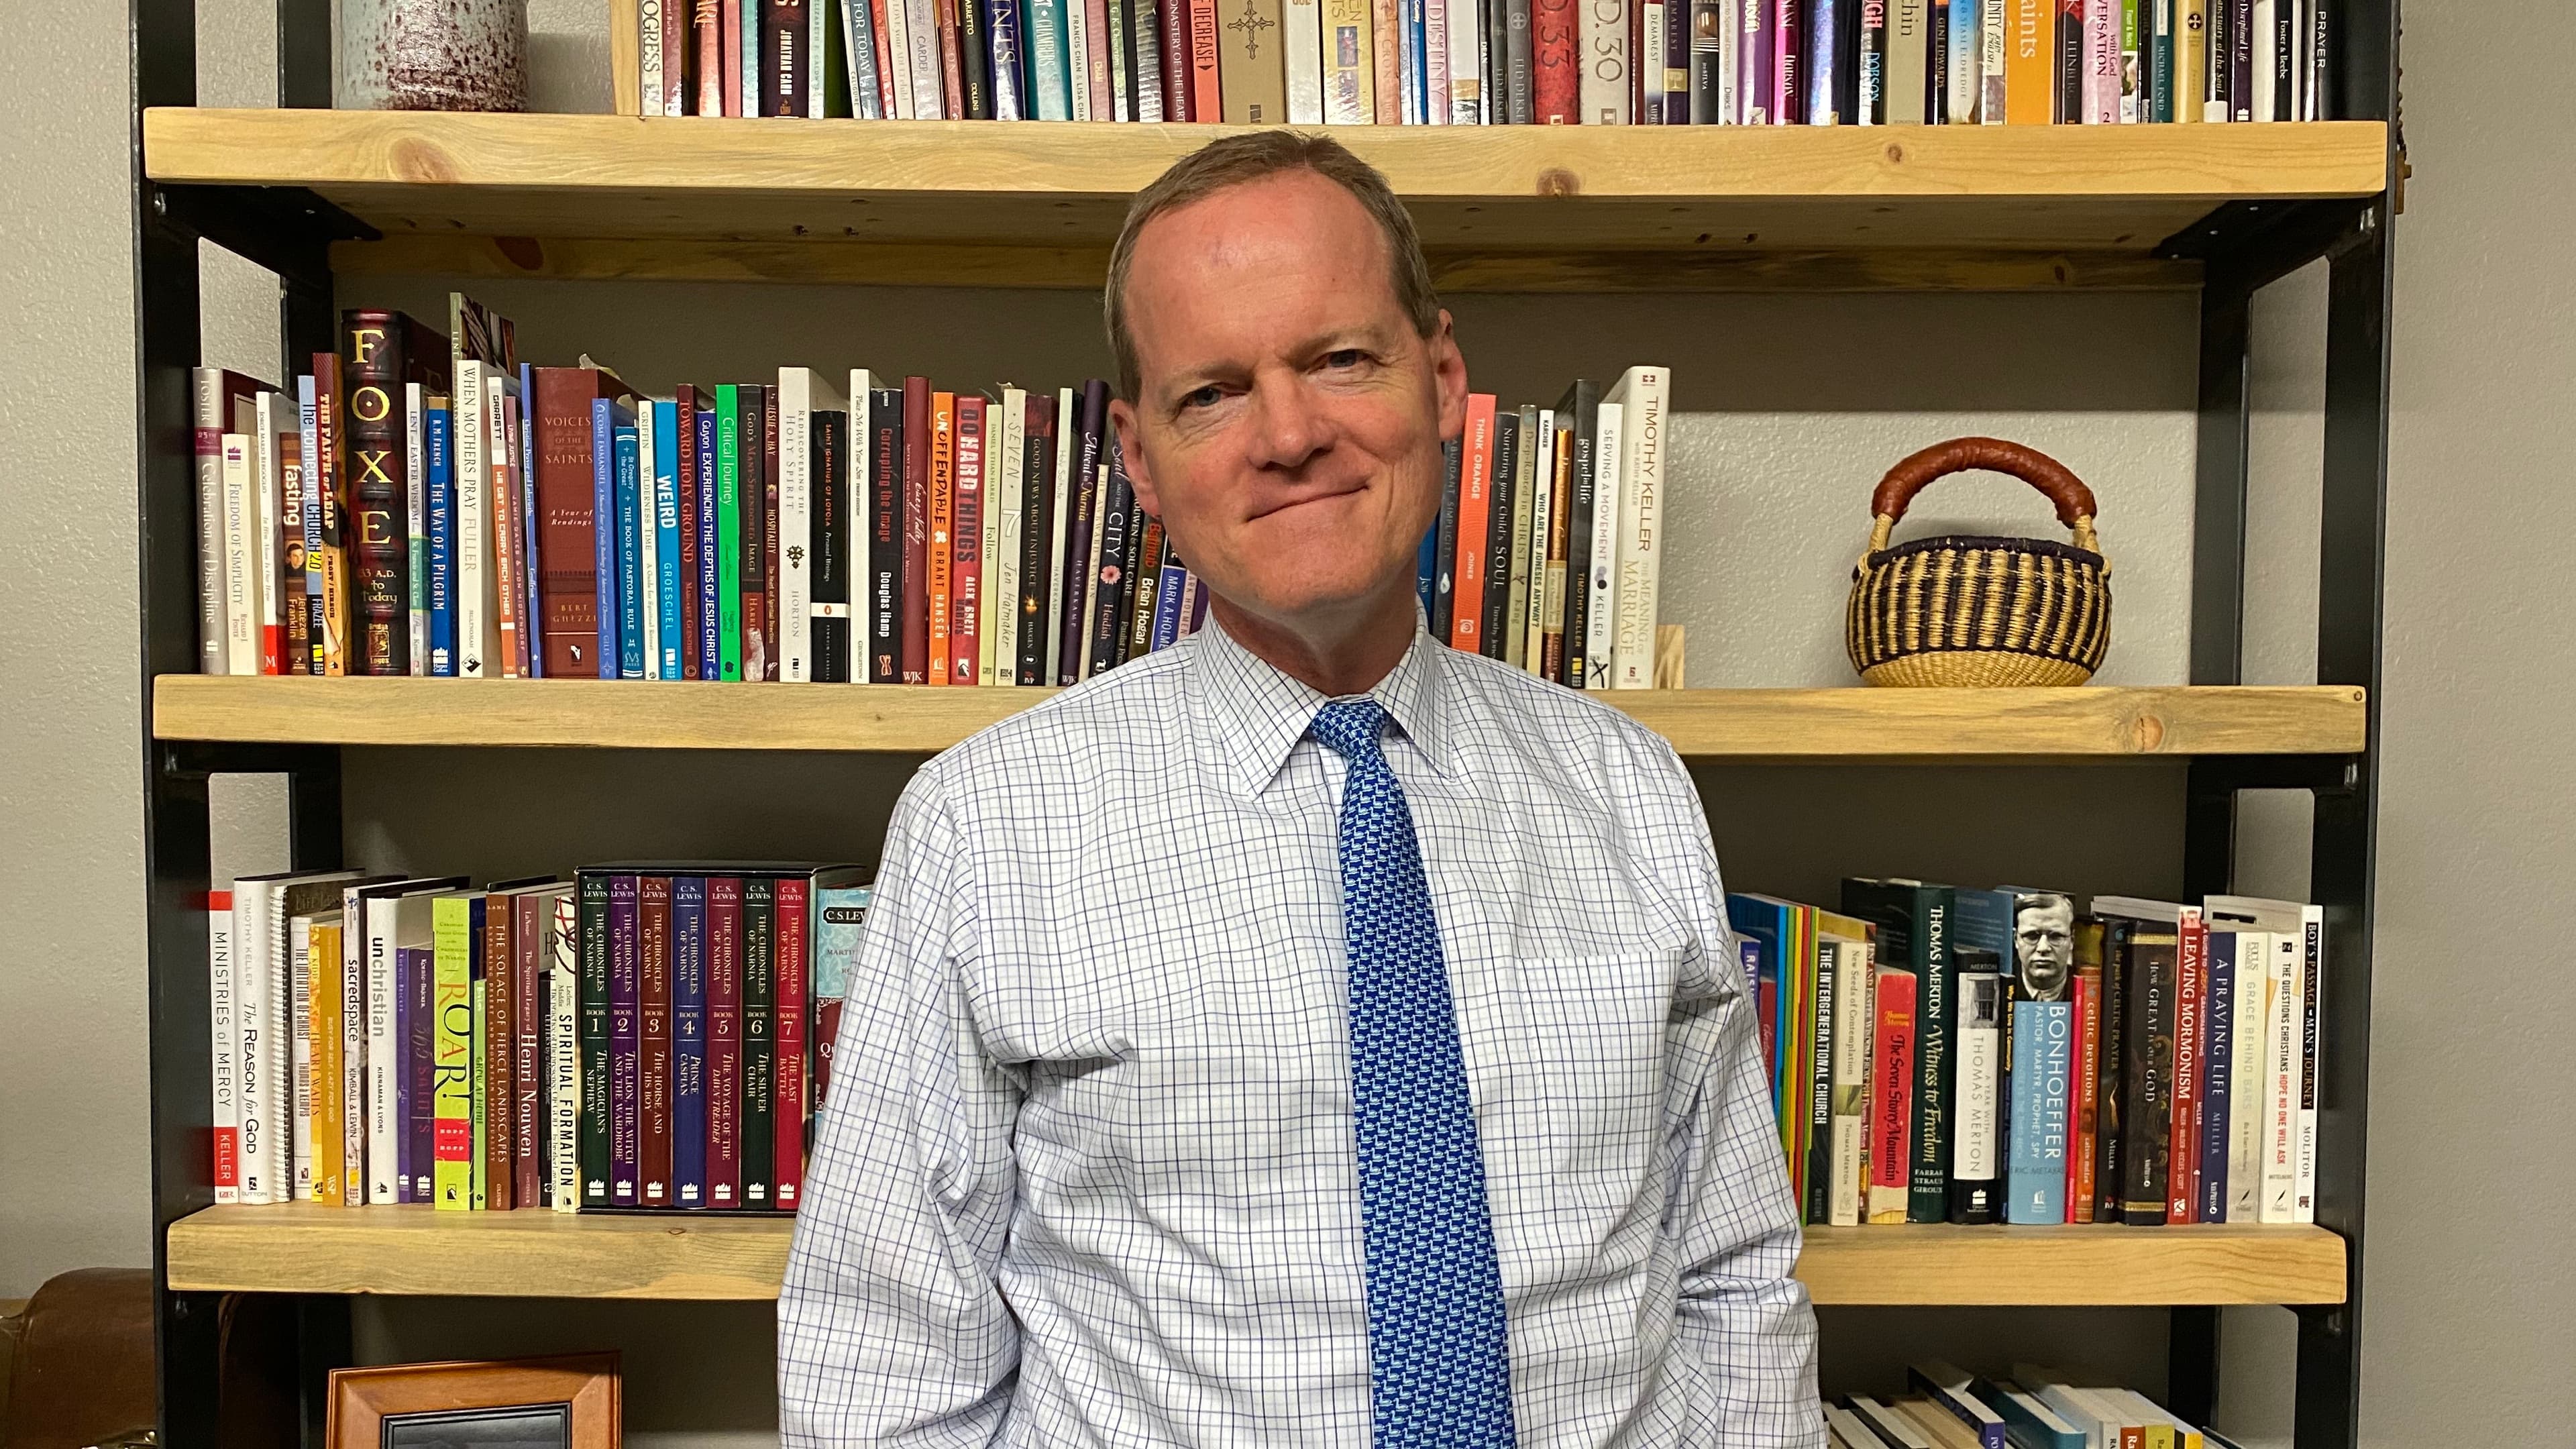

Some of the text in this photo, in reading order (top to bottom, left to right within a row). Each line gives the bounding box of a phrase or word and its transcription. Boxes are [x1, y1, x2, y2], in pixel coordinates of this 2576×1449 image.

[780, 30, 792, 70] JONATHAN
[853, 3, 870, 72] FOR TODAY
[1036, 19, 1056, 66] CHAMBERS
[1173, 52, 1182, 66] OF
[1194, 8, 1214, 61] DECREASE
[1427, 3, 1445, 97] DESTINY
[1542, 25, 1570, 68] 33
[2280, 20, 2288, 44] Foster
[2317, 11, 2326, 68] PRAYER
[971, 83, 979, 111] COLLINS
[1175, 68, 1183, 89] THE
[2109, 57, 2118, 76] God
[2216, 73, 2224, 93] Soul
[493, 394, 502, 441] GARRETT
[1007, 422, 1021, 478] SEVEN
[303, 402, 321, 570] The Connecting CHURCH 2.0
[464, 368, 477, 571] WHEN MOTHERS PRAY FULLER
[680, 400, 693, 562] TOWARD HOLY GROUND
[720, 417, 735, 506] Critical Journey
[786, 416, 796, 510] HOLY SPIRIT
[933, 411, 949, 524] UNOFFENDABLE
[1471, 418, 1485, 499] THINK ORANGE
[1601, 429, 1614, 480] SERVING
[1638, 396, 1658, 551] TIMOTHY KELLER
[201, 463, 219, 540] Celebration
[283, 465, 302, 525] fasting
[431, 482, 445, 505] THE
[433, 508, 445, 534] WAY
[657, 475, 676, 529] WEIRD
[229, 484, 244, 604] FREEDOM OF SIMPLICITY
[433, 537, 445, 551] OF
[699, 421, 716, 663] Guyon EXPERIENCING THE DEPTHS OF JESUS CHRIST
[985, 527, 996, 560] Follow
[1106, 512, 1124, 558] CITY
[1598, 494, 1611, 559] MOVEMENT
[204, 559, 221, 624] Discipline
[433, 564, 446, 610] PILGRIM
[879, 572, 892, 608] Douglas
[1532, 494, 1546, 627] WHO ARE THE JONESES ANYWAY?
[313, 598, 323, 628] FRAZEE
[664, 563, 673, 631] GROESCHEL
[934, 550, 945, 639] BRANT HANSEN
[1002, 563, 1017, 648] Jen Hatmaker
[1135, 578, 1154, 643] Brian Hogan
[1593, 596, 1604, 637] KELLER
[372, 936, 388, 1037] unchristian
[1928, 906, 1943, 1018] THOMAS MERTON
[215, 932, 231, 1106] MINISTRIES of MERCY
[343, 959, 361, 1042] sacredspace
[2033, 1006, 2043, 1042] PASTOR,
[2178, 936, 2197, 1099] LEAVING MORMONISM
[2212, 959, 2228, 1095] A PRAYING LIFE
[2304, 924, 2317, 1106] BOY'S PASSAGE MAN'S JOURNEY
[496, 924, 507, 1163] THE SOLACE OF FIERCE LANDSCAPES
[625, 1051, 635, 1071] THE
[1815, 949, 1833, 1124] THE INTERGENERATIONAL CHURCH
[242, 1003, 260, 1154] The REASON for GOD
[520, 1034, 537, 1158] Henri Nouwen
[559, 1014, 574, 1186] SPIRITUAL FORMATION
[586, 1069, 595, 1113] NEPHEW
[596, 1050, 608, 1134] THE MAGICIAN'S
[1886, 1034, 1905, 1181] The Seven Storey Mountain
[1923, 1024, 1943, 1163] Witness to Freedom
[2044, 1006, 2065, 1159] BONHOEFFER
[625, 1105, 633, 1126] THE
[625, 1130, 634, 1164] WITCH
[2031, 1093, 2041, 1138] PROPHET,
[220, 1134, 231, 1179] KELLER
[2031, 1142, 2040, 1158] SPY
[2302, 1126, 2311, 1179] MOLITOR
